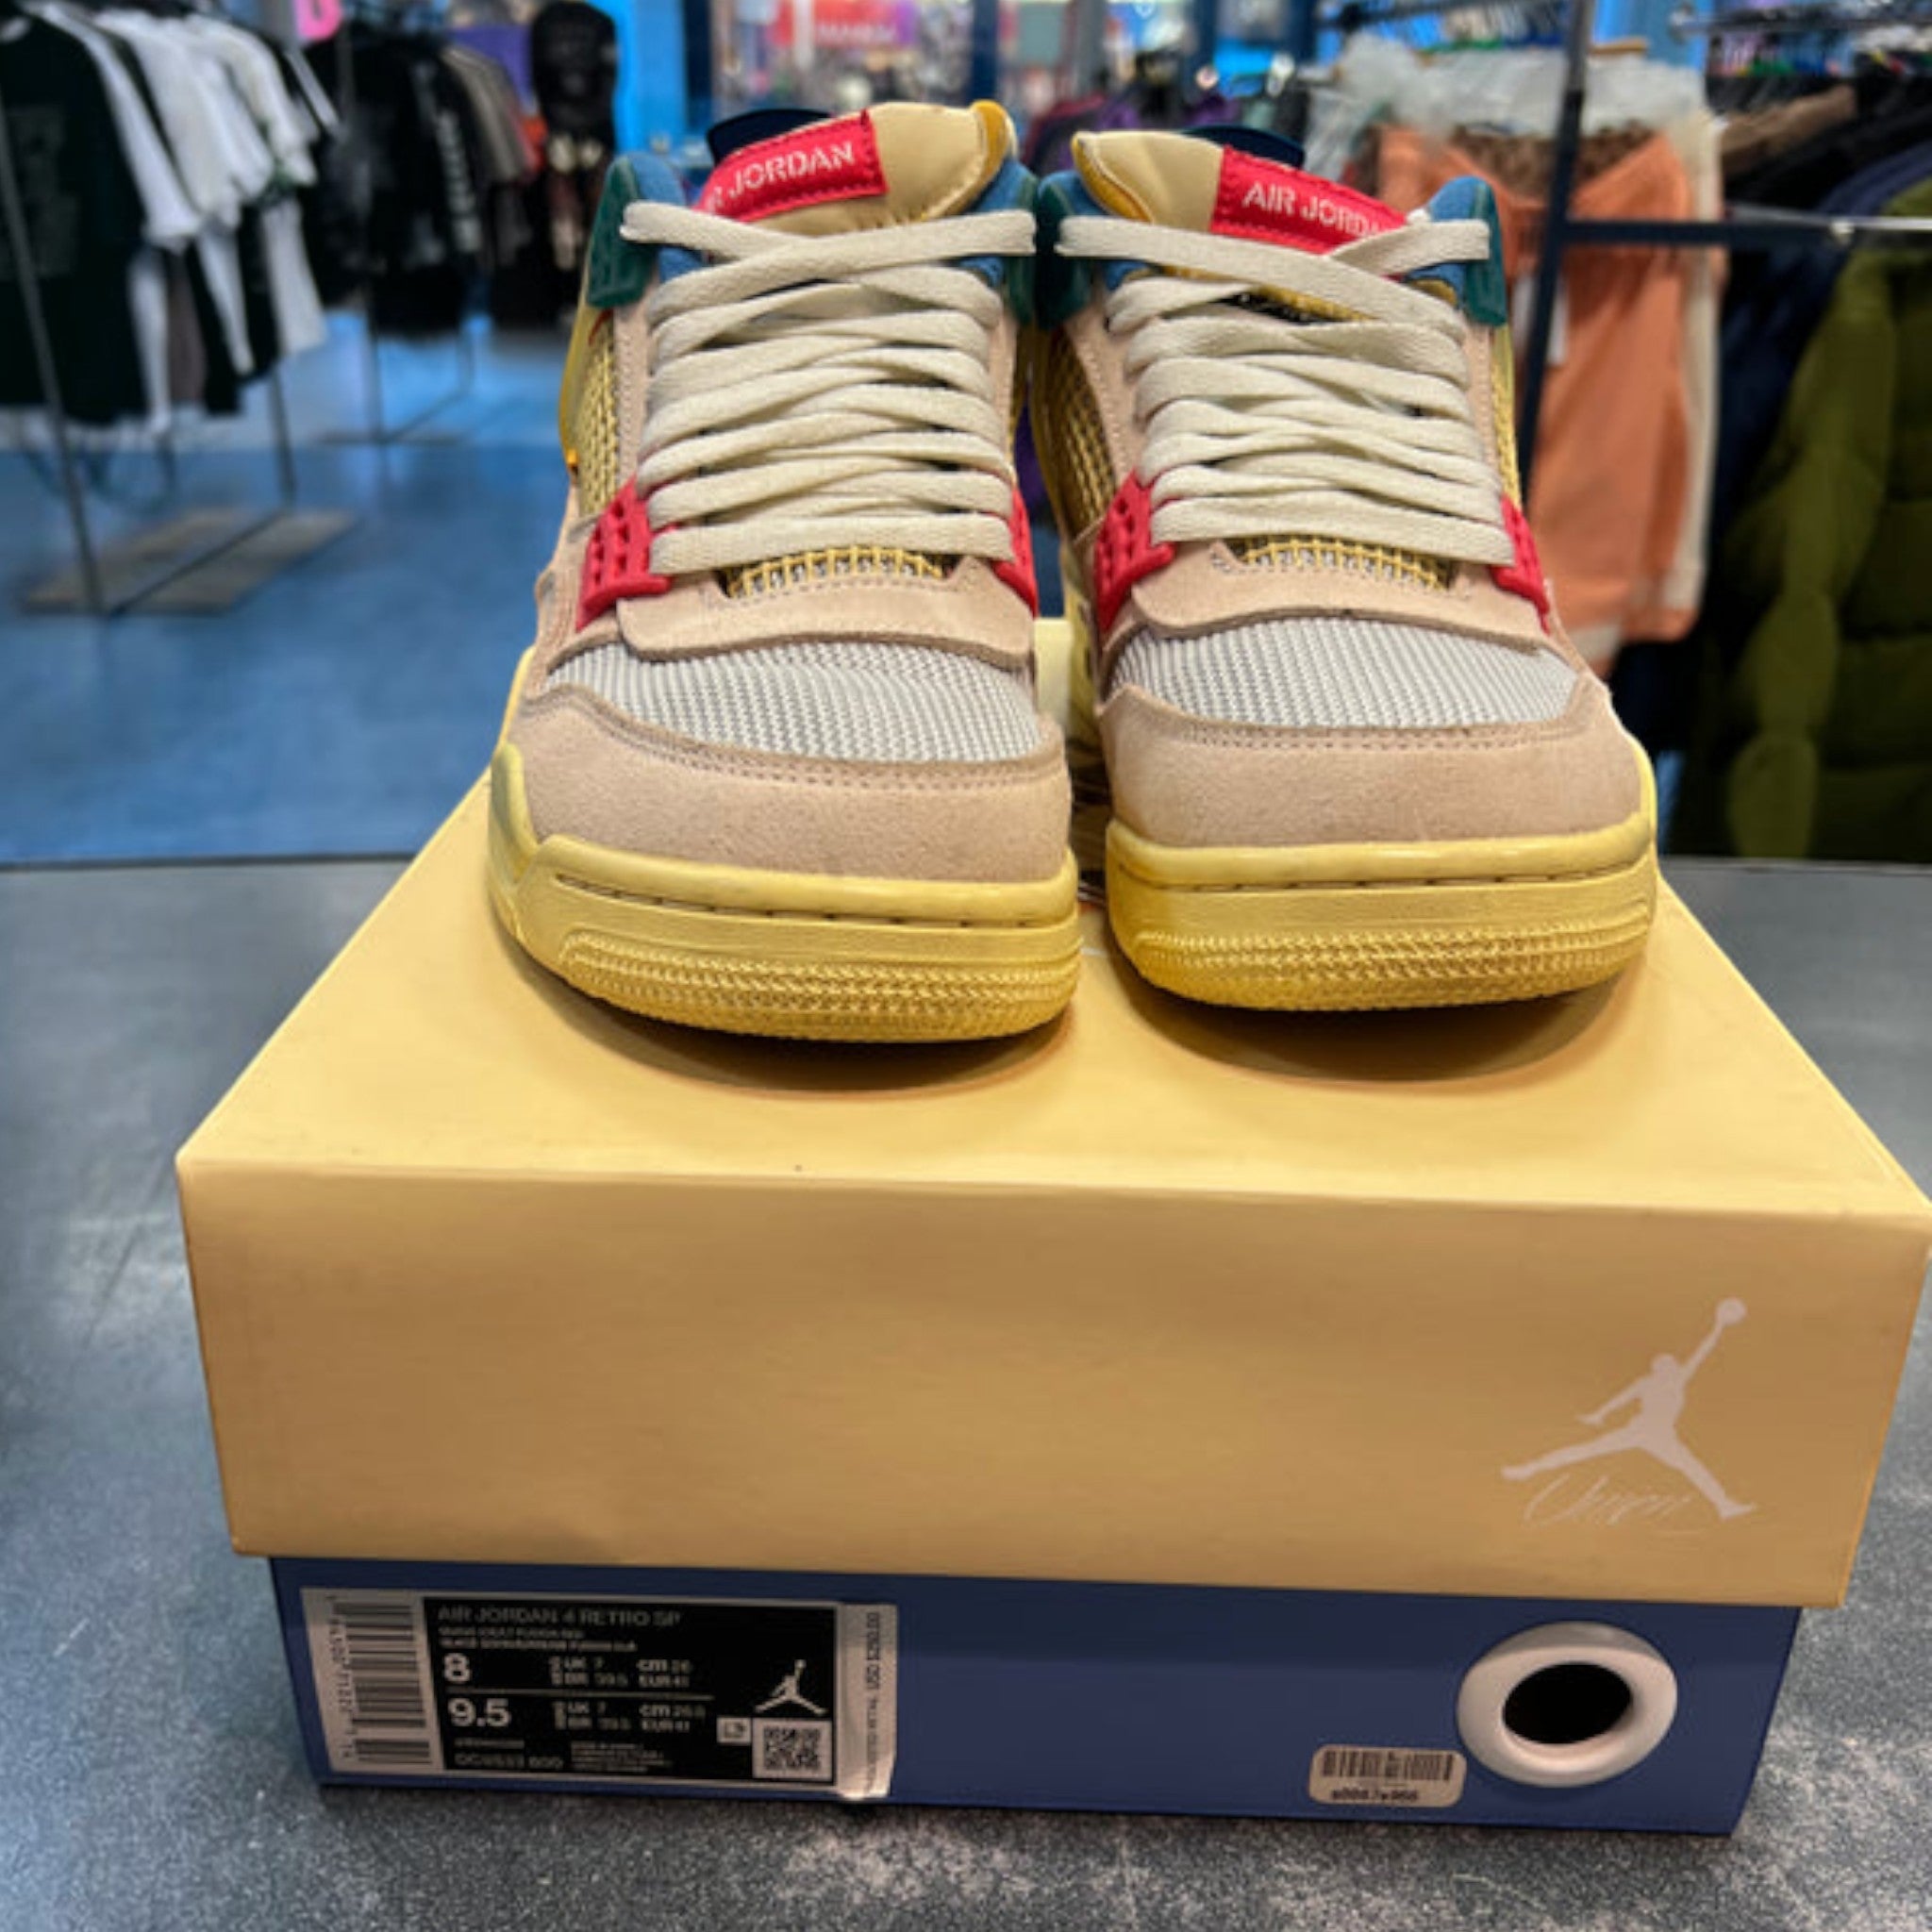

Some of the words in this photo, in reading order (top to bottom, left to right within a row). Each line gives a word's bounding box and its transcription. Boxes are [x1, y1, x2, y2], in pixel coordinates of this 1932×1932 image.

[729, 142, 856, 199] JORDAN
[1241, 181, 1296, 215] AIR
[1301, 195, 1381, 237] JORDA
[438, 1606, 471, 1622] AIR
[474, 1607, 558, 1624] JORDAN
[580, 1609, 649, 1626] RETRO
[443, 1652, 471, 1684] 8
[447, 1697, 511, 1728] 9.5
